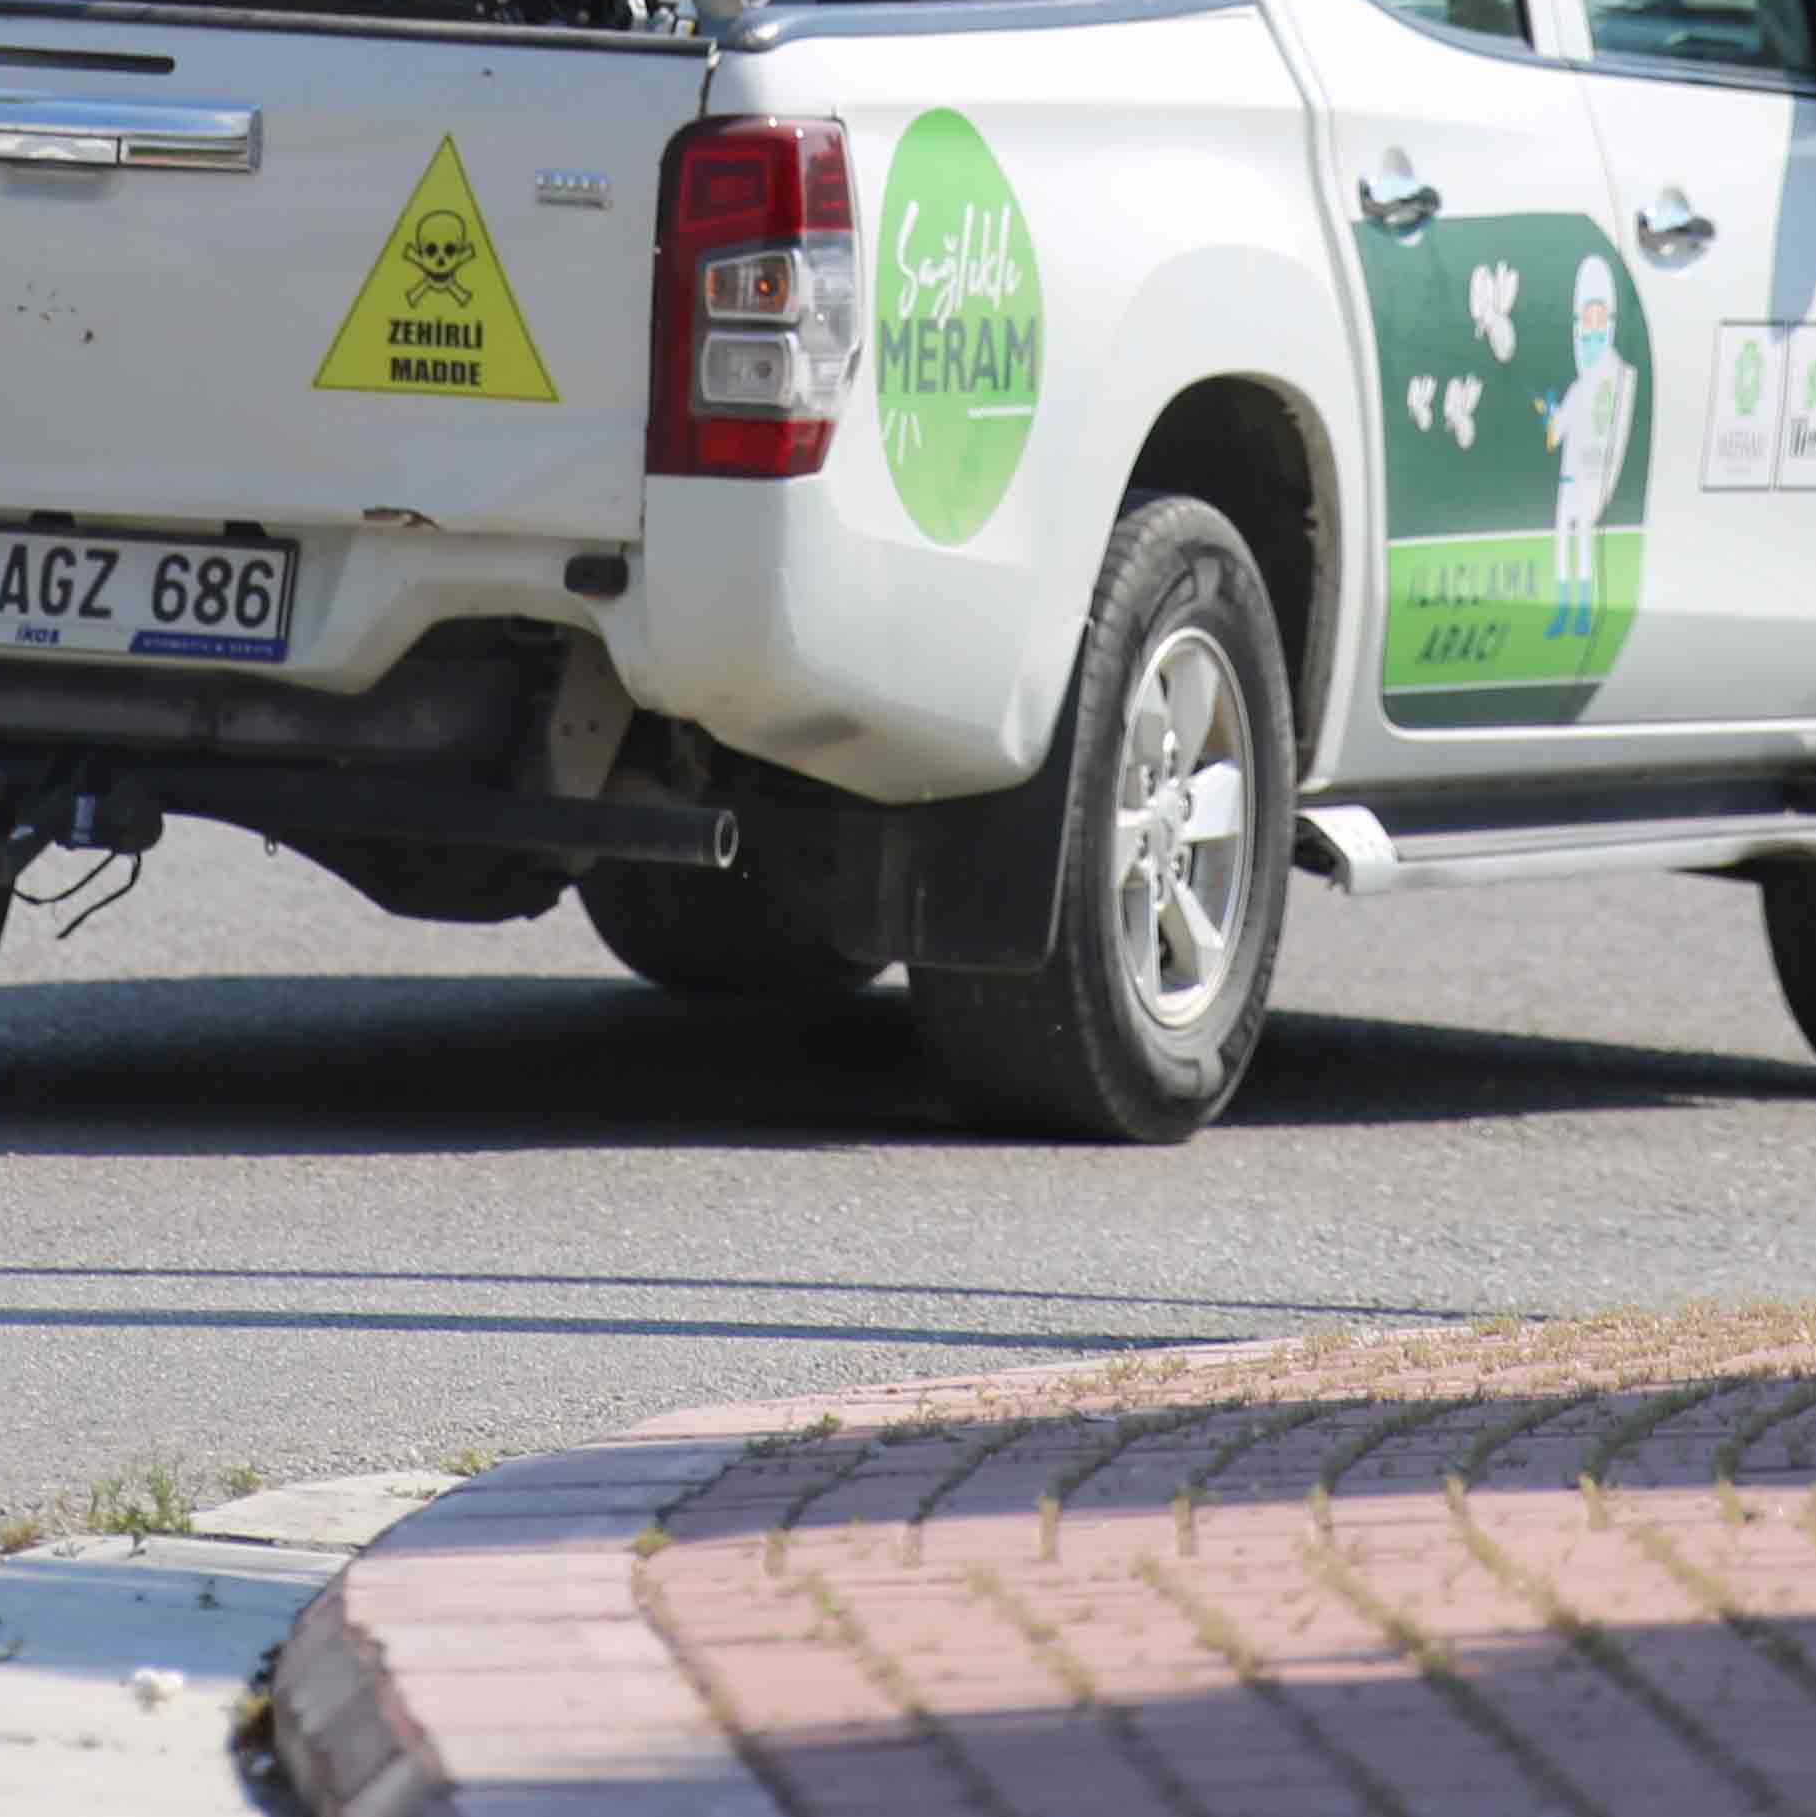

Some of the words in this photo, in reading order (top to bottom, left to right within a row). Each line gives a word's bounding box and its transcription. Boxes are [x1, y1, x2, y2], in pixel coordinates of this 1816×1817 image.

[387, 317, 483, 349] ZEHİRLİ
[879, 315, 1037, 393] MERAM
[390, 357, 482, 387] MADDE
[151, 554, 275, 627] 686
